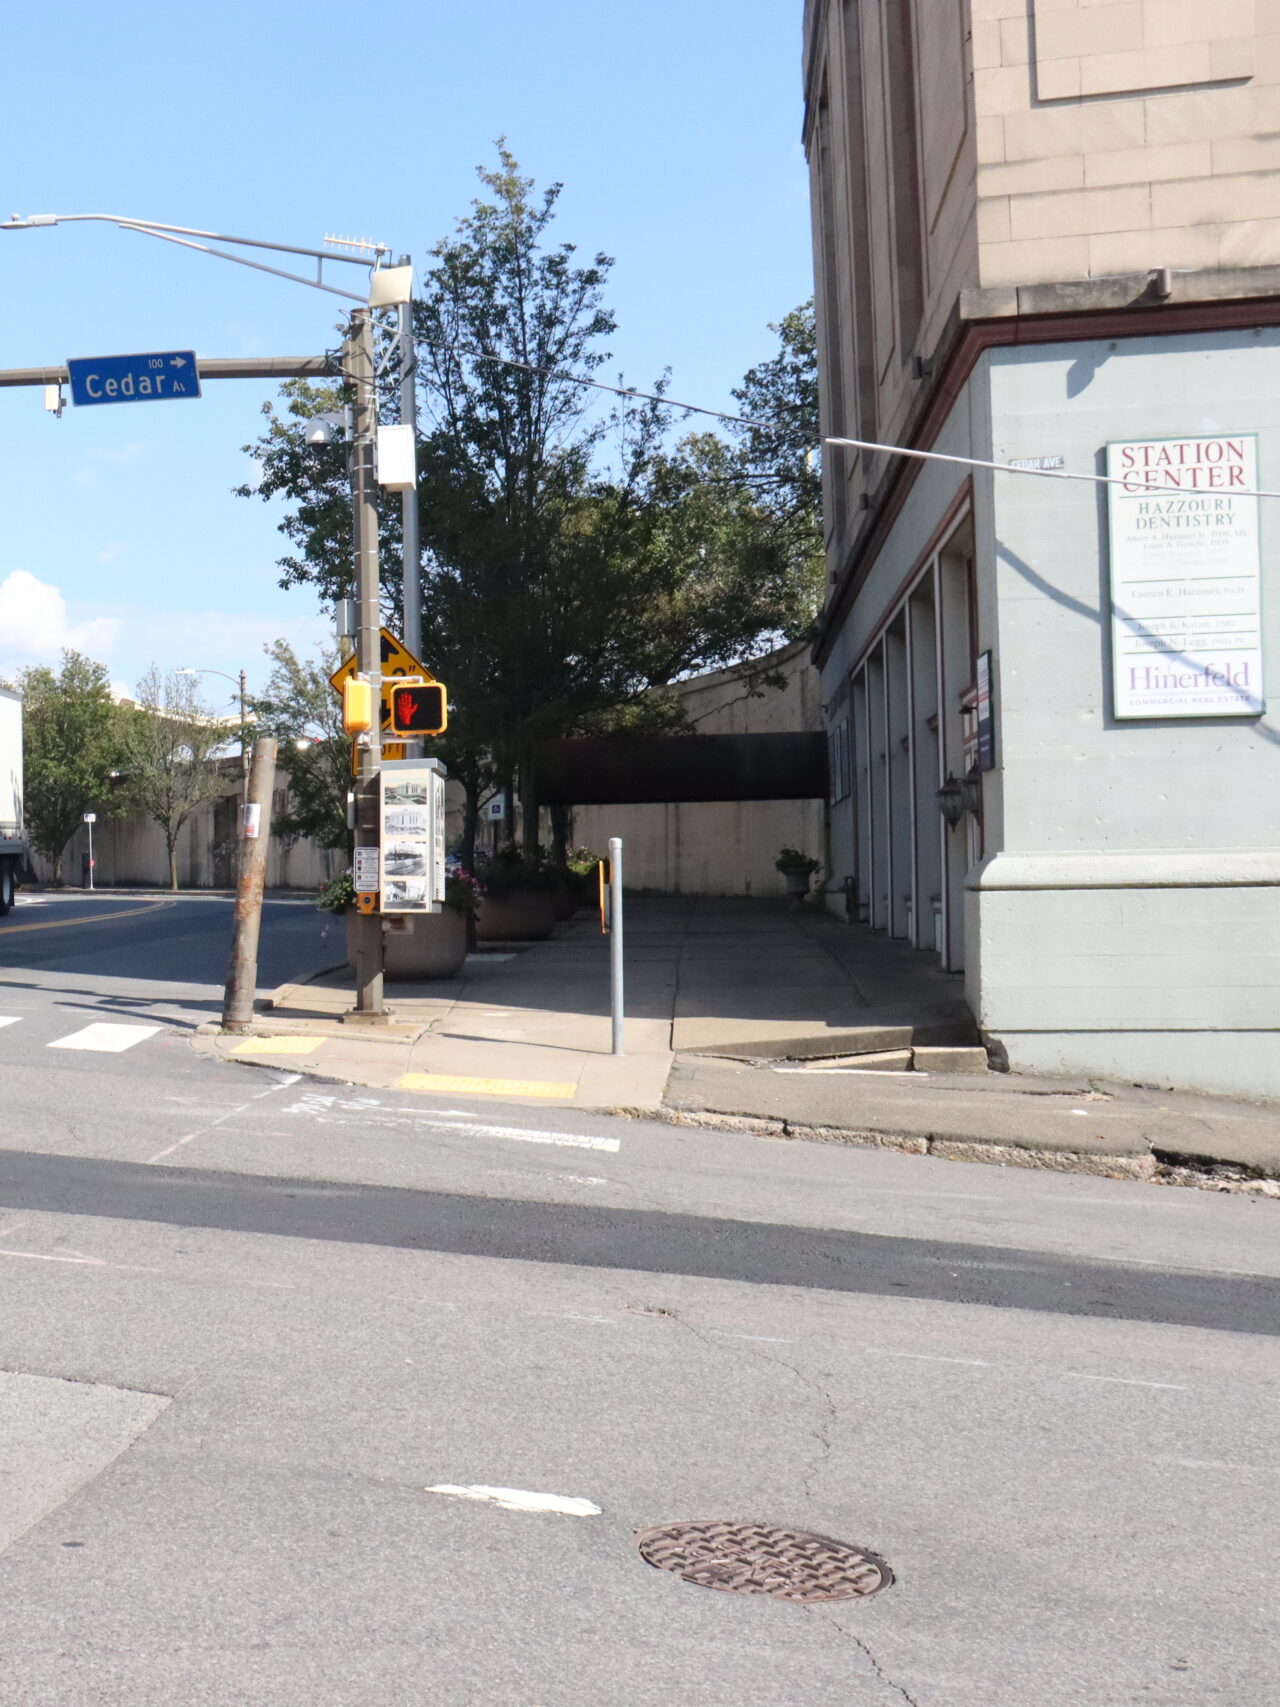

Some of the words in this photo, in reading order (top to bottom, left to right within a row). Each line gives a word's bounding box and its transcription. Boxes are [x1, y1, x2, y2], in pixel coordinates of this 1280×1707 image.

[148, 358, 163, 369] 100
[85, 372, 165, 398] Cedar
[1121, 440, 1246, 469] STATION
[1122, 465, 1246, 492] CENTER
[1138, 498, 1233, 515] HAZZOURI
[1136, 512, 1236, 530] DENTISTRY
[1131, 589, 1164, 599] Lauren
[1137, 621, 1167, 632] Joseph
[1135, 638, 1167, 649] Joseph
[1128, 661, 1252, 690] Hinerfeld
[1129, 696, 1189, 707] COMMERCIAL
[1191, 695, 1215, 705] REAL
[1217, 694, 1251, 703] ESTATE
